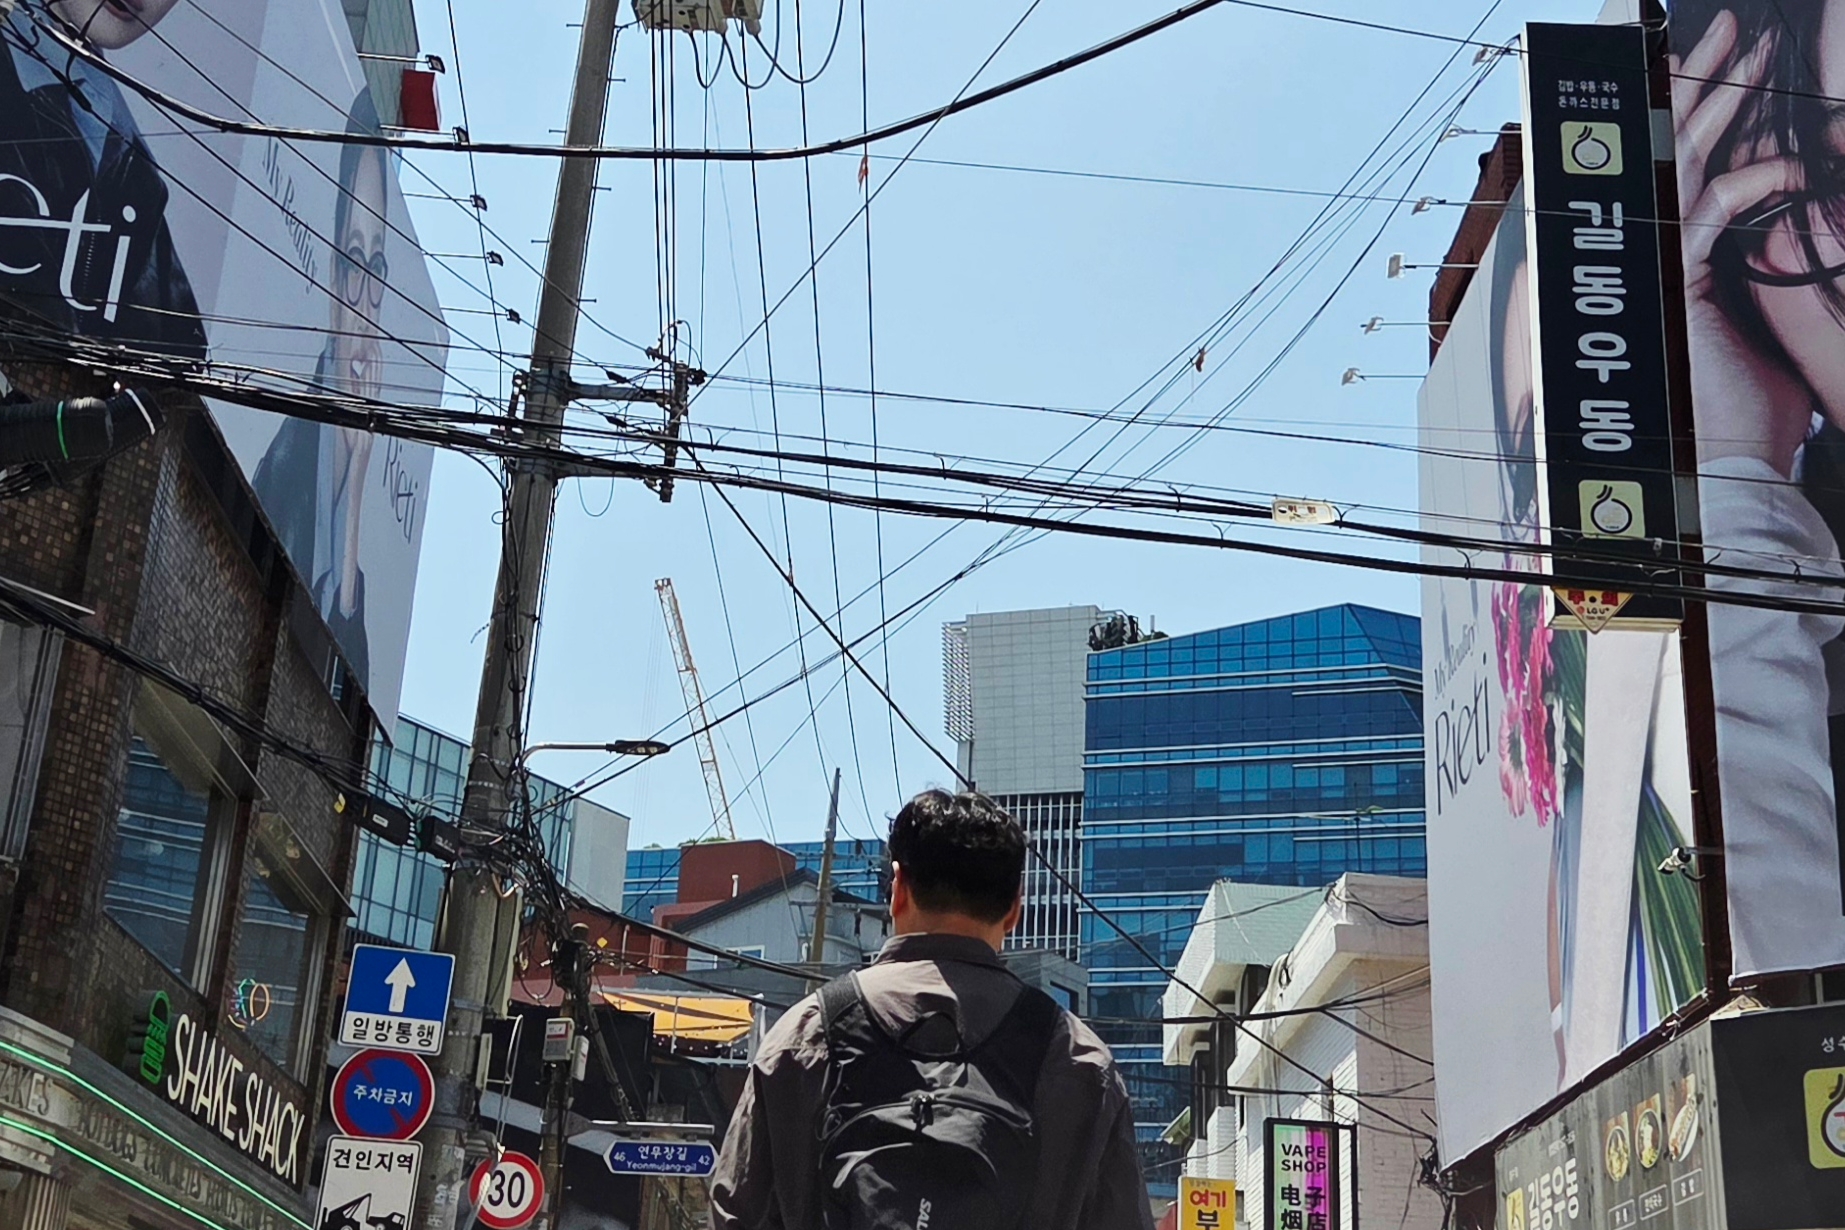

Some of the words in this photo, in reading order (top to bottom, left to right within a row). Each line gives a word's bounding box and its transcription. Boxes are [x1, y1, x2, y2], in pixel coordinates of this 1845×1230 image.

[282, 179, 318, 295] Reality
[1568, 200, 1635, 453] 길동우동
[383, 436, 418, 543] Rieti
[1434, 652, 1491, 816] Rieti
[352, 1016, 435, 1047] 일방통행
[166, 1014, 244, 1142] SHAKE
[239, 1072, 306, 1184] SHACK
[353, 1084, 413, 1107] 주차금지
[331, 1148, 415, 1174] 견인지역
[613, 1151, 626, 1162] 46
[638, 1145, 688, 1161] 연무장길
[698, 1154, 711, 1166] 42
[1281, 1143, 1327, 1159] VAPE
[626, 1160, 697, 1172] Yeonmujang-gil
[1281, 1159, 1327, 1173] SHOP
[487, 1170, 525, 1208] 30
[1189, 1188, 1227, 1208] 여기
[1280, 1184, 1327, 1209] 电子
